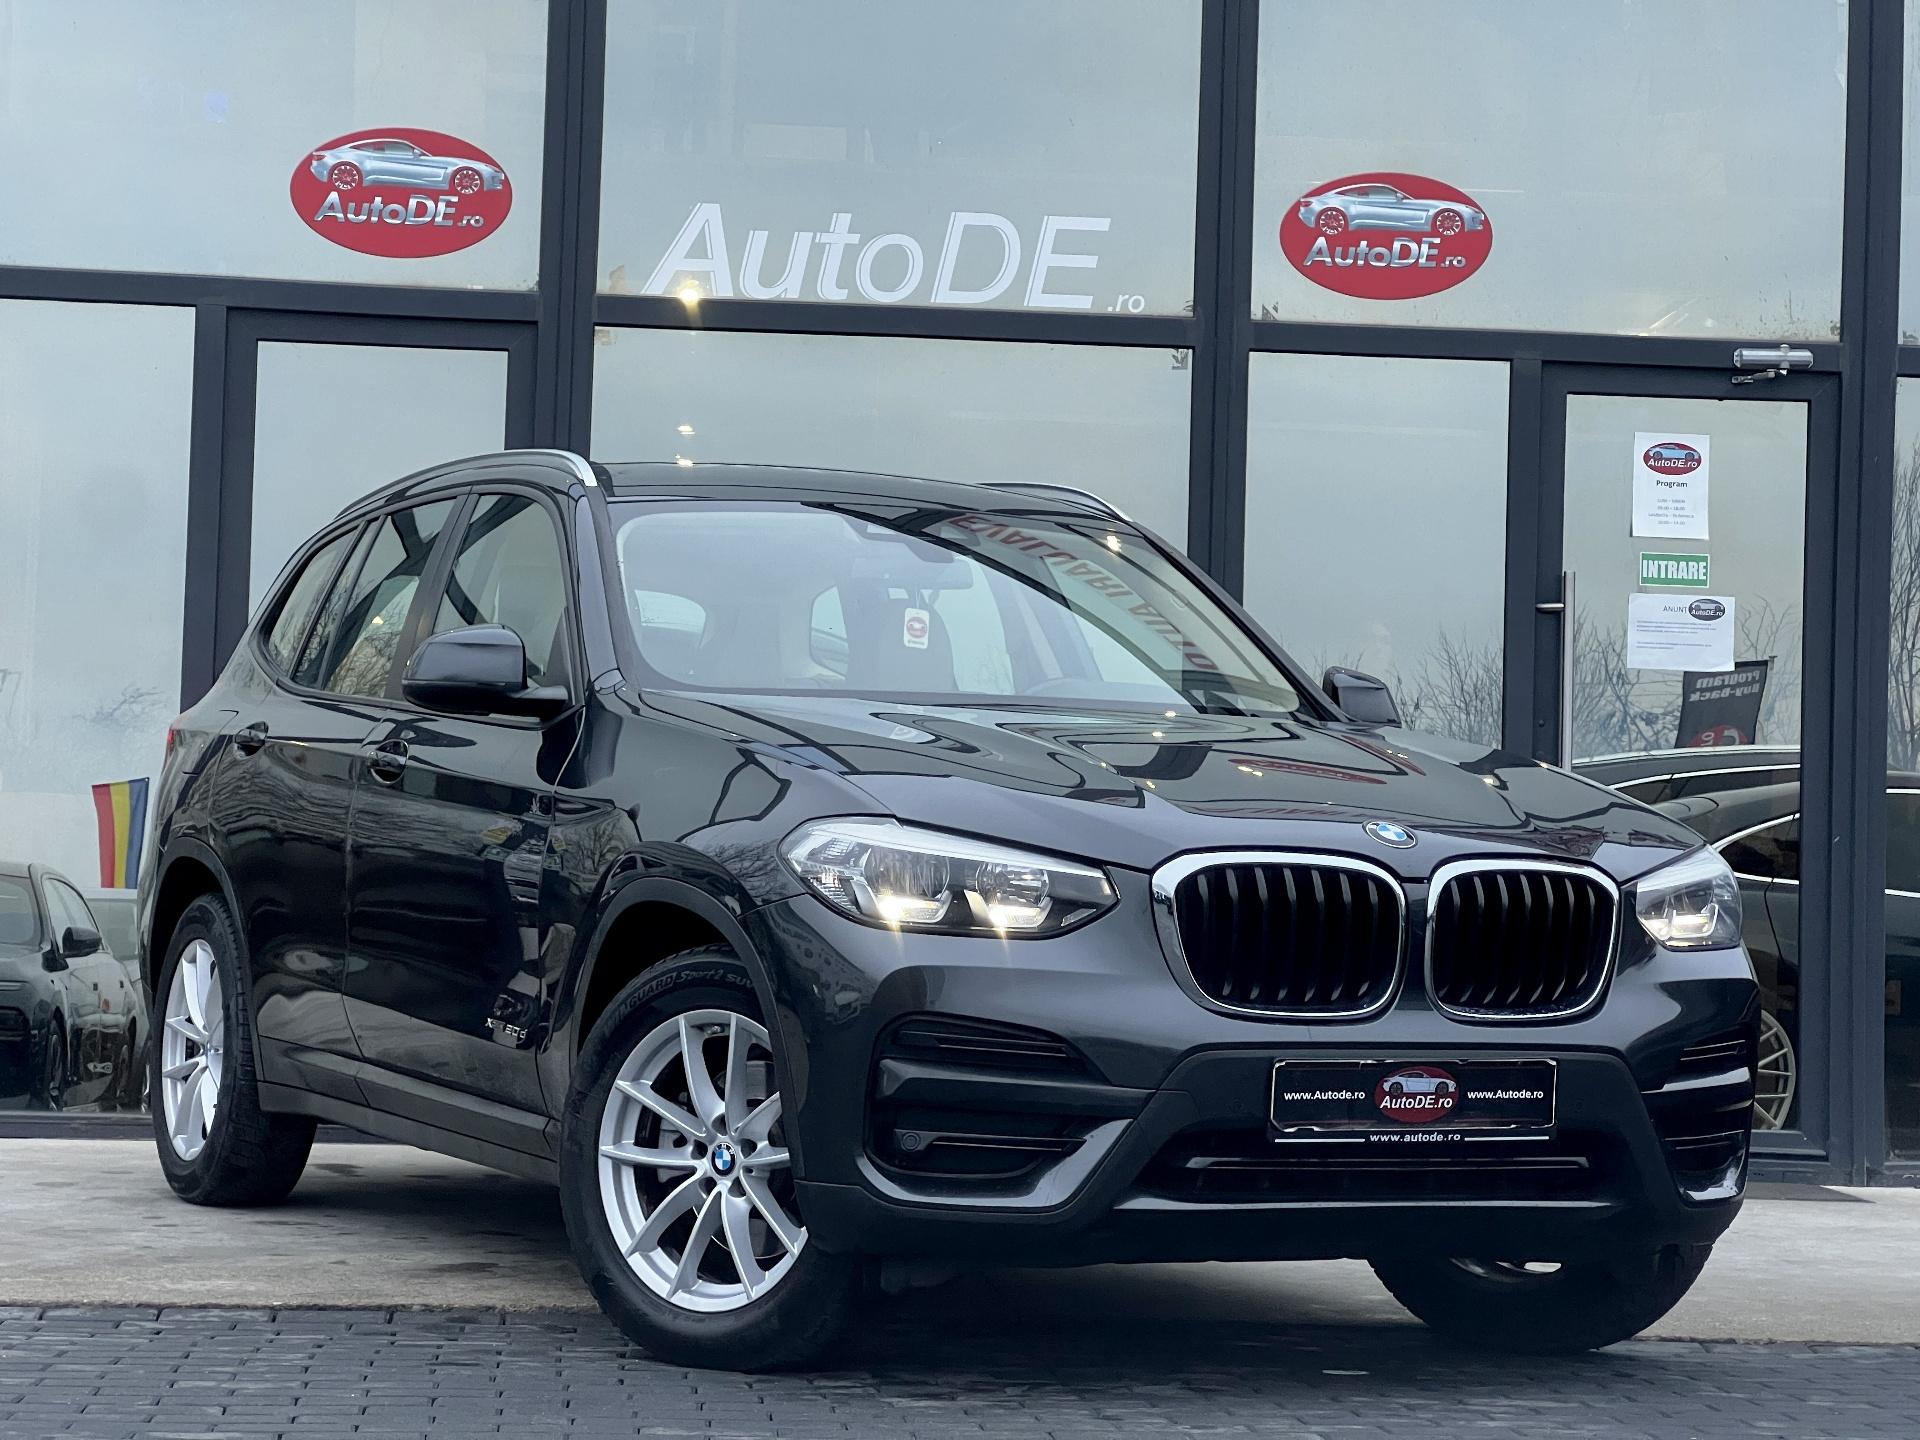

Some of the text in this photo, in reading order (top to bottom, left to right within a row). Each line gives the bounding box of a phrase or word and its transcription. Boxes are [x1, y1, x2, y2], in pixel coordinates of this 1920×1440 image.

[314, 190, 485, 228] AutoDE.ro
[641, 202, 1146, 314] AutoDE.ro
[1303, 236, 1467, 268] AutoDE.ro
[1647, 458, 1698, 468] AutoDE.ro
[1656, 480, 1688, 488] Program
[1642, 559, 1707, 580] INTRARE
[1691, 608, 1723, 616] AutoDE.ro
[1284, 1089, 1366, 1101] www.Autode.ro
[1467, 1088, 1544, 1100] www.Autode.ro
[1379, 1095, 1453, 1109] AutoDE.ro
[1369, 1131, 1461, 1143] www.autode.ro
